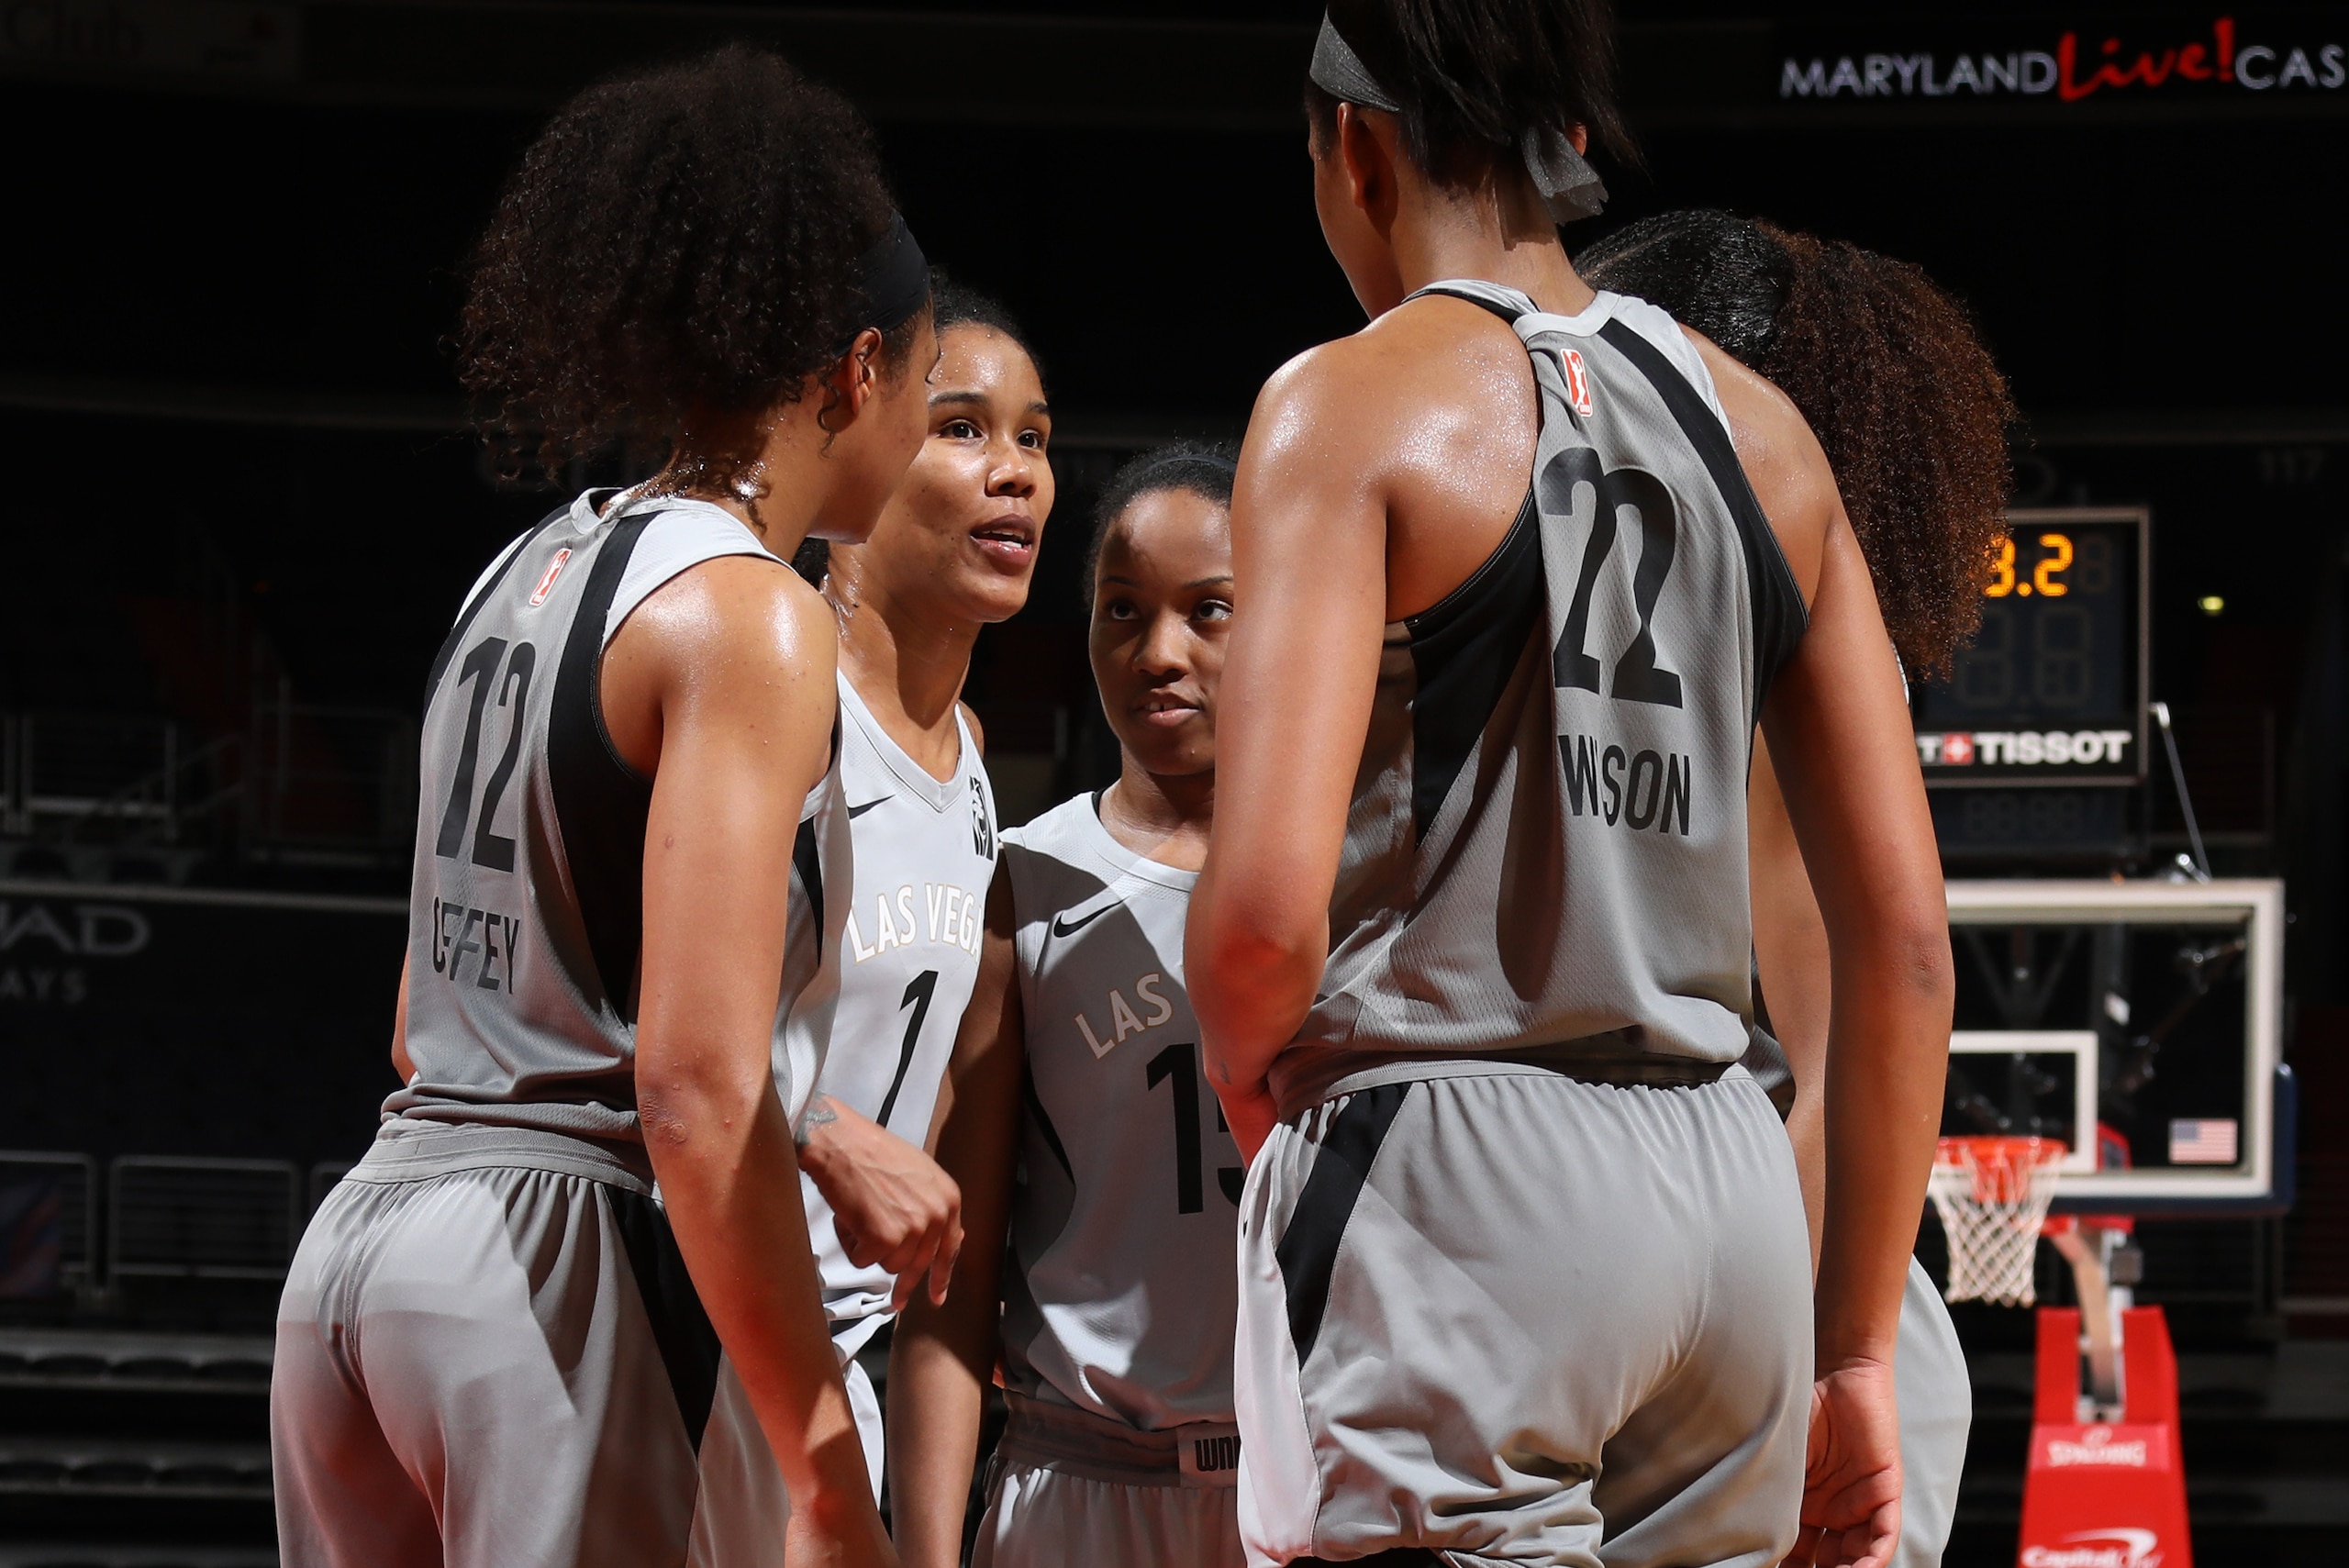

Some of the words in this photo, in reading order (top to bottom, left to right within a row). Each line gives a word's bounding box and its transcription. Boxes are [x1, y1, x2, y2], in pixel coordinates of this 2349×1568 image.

[1780, 51, 2058, 97] MARYLAND
[2057, 17, 2235, 102] Live!
[2235, 44, 2347, 90] CAS
[1541, 447, 1684, 709] 22
[436, 636, 536, 873] 12
[1974, 729, 2133, 766] TISSOT
[0, 899, 153, 957] AD
[846, 884, 917, 963] LAS
[875, 969, 939, 1129] 1
[1074, 973, 1173, 1060] LAS
